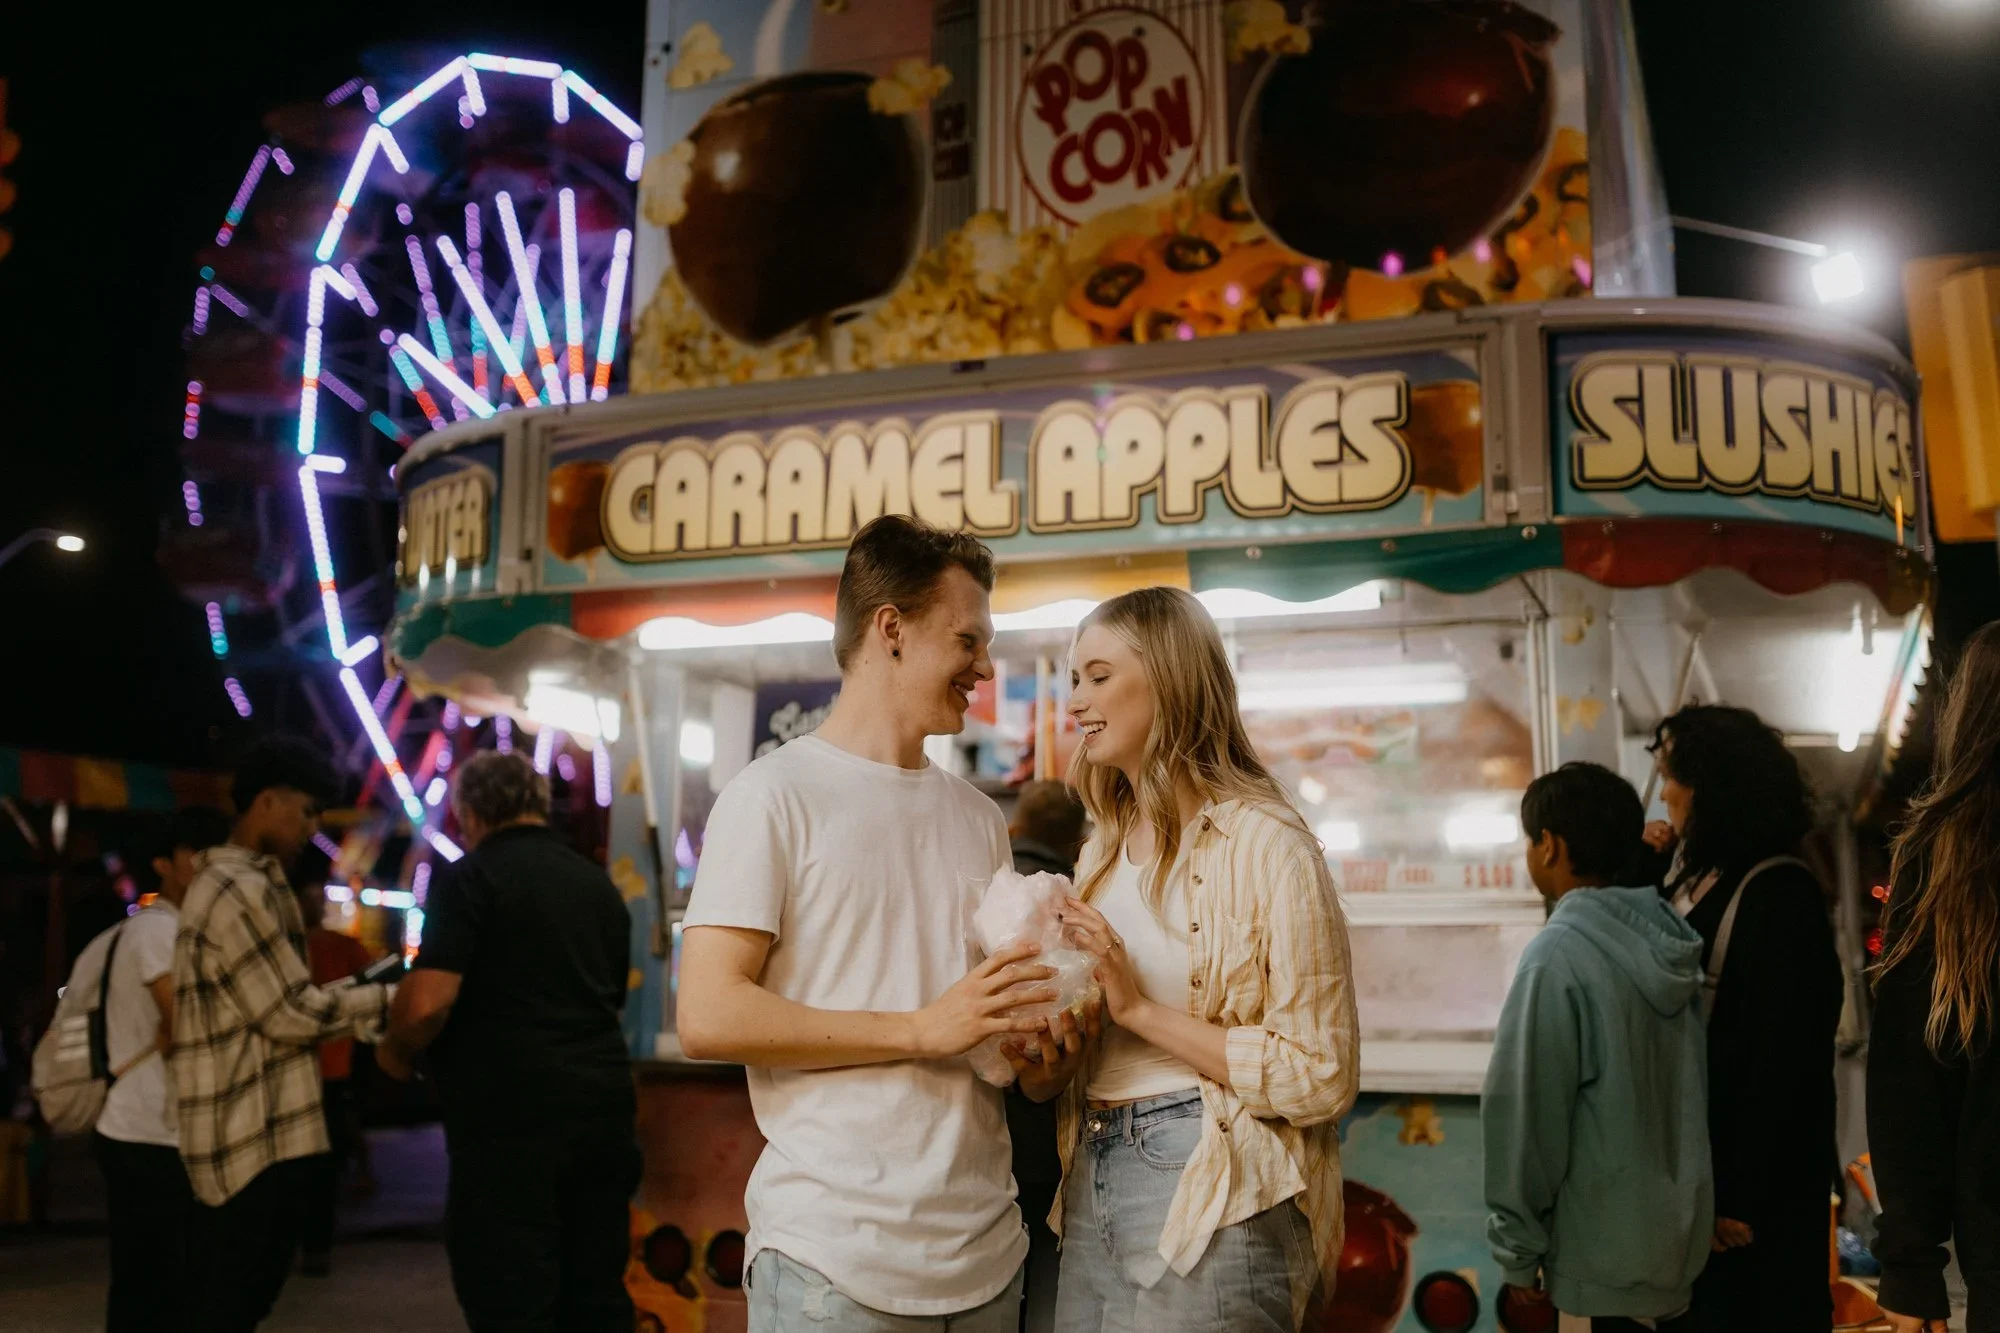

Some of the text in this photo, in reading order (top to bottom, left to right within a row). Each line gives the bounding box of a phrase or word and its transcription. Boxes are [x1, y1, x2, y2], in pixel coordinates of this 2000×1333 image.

[1033, 30, 1148, 137] POP
[1050, 74, 1193, 203] CORN
[605, 377, 1408, 558] CARAMEL APPLES
